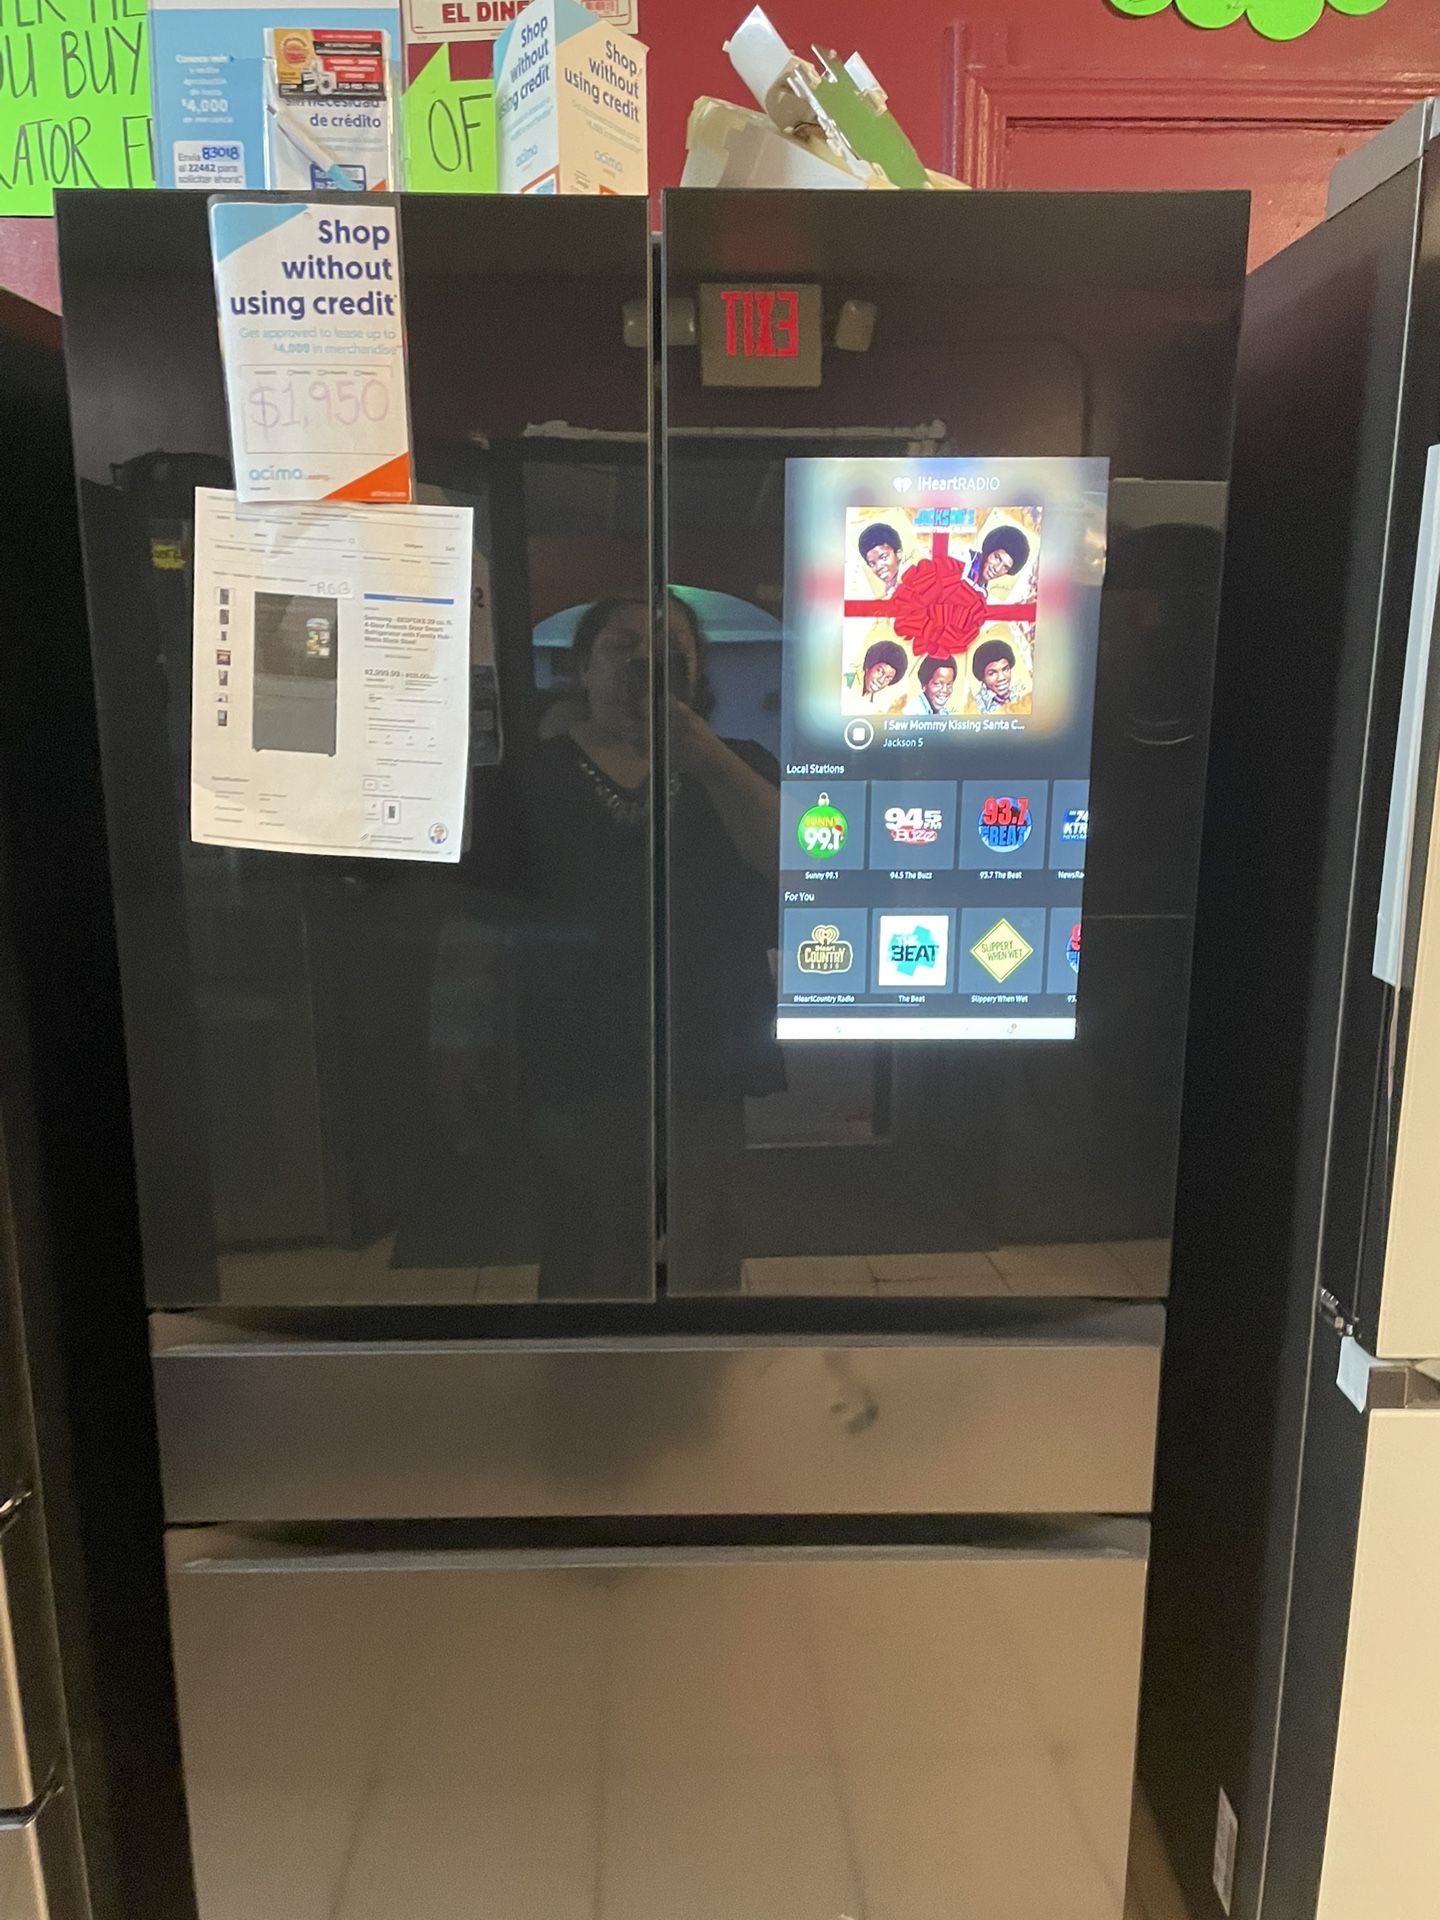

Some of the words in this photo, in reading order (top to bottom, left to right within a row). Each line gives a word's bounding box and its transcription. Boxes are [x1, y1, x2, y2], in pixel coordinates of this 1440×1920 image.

[442, 2, 470, 24] EL
[521, 15, 548, 48] Shop
[61, 22, 142, 98] BUY
[510, 39, 549, 83] without
[605, 40, 638, 77] Shop
[520, 64, 550, 100] credit
[565, 67, 600, 104] using
[589, 57, 639, 99] without
[310, 113, 328, 127] de
[332, 114, 381, 129] crédito
[0, 116, 103, 189] ATOR
[202, 146, 239, 160] 83018
[318, 219, 390, 250] Shop
[281, 255, 392, 280] without
[231, 290, 305, 320] using
[249, 379, 390, 440] $1,950
[249, 465, 303, 481] acima
[889, 720, 907, 731] Saw
[909, 720, 947, 732] Mommy
[948, 720, 980, 732] Kissing
[982, 720, 1010, 731] Santa
[1011, 720, 1025, 731] C...
[883, 738, 917, 748] Jackson
[917, 738, 924, 748] 5
[786, 763, 809, 774] Local
[809, 763, 845, 774] Stations
[982, 796, 1029, 826] 93.7
[805, 815, 841, 828] SUNNY
[803, 827, 841, 851] 99.1
[989, 825, 1027, 847] BEAT
[805, 871, 825, 880] Sunny
[825, 871, 839, 880] 99.1
[889, 871, 904, 880] 94.5
[904, 871, 917, 880] The
[917, 871, 933, 880] Buzz
[979, 871, 994, 880] 93.7
[994, 871, 1006, 880] The
[1007, 871, 1022, 880] Beat
[784, 891, 798, 901] For
[799, 891, 815, 901] You
[891, 945, 938, 962] BEAT
[981, 940, 1013, 953] SLIPPERY
[987, 950, 1007, 961] WHEN
[1008, 949, 1023, 959] WET
[837, 995, 855, 1003] Radio
[898, 995, 910, 1003] The
[911, 995, 926, 1003] Beat
[971, 995, 998, 1003] Slippery
